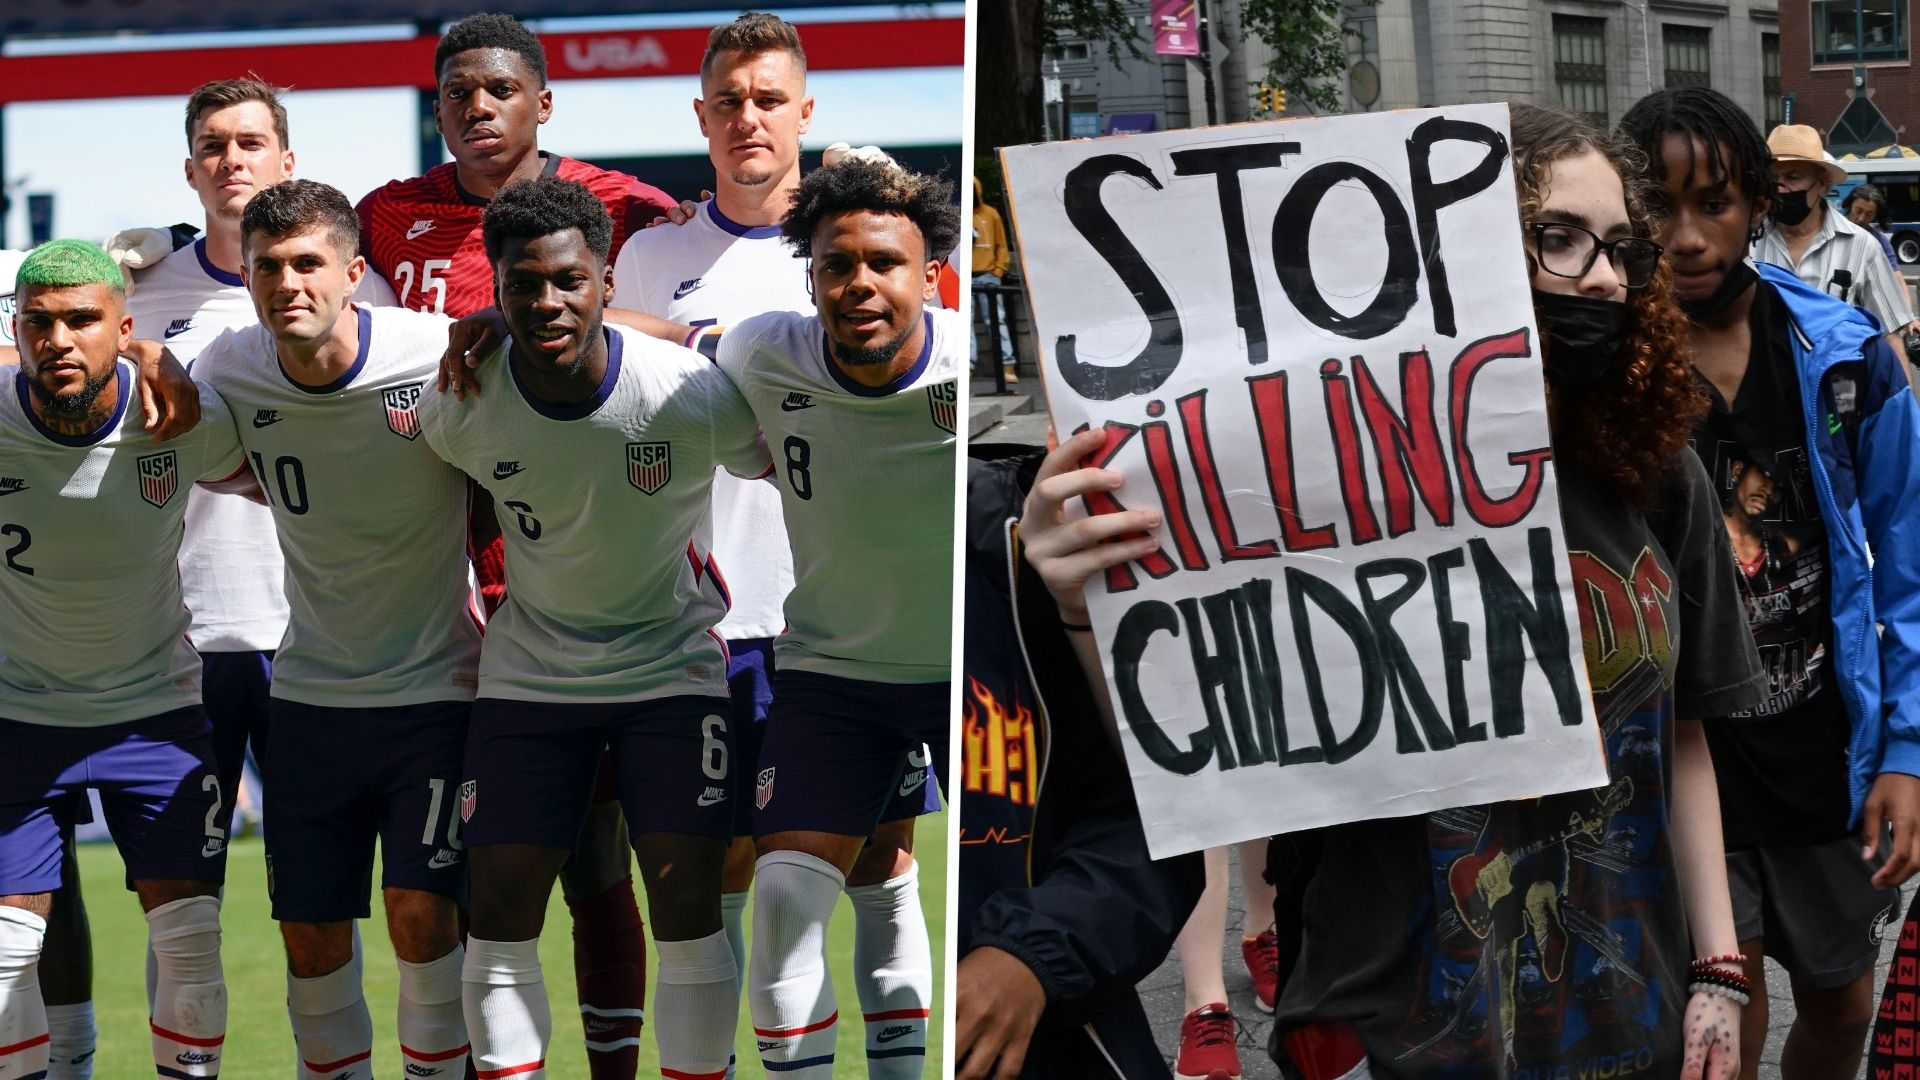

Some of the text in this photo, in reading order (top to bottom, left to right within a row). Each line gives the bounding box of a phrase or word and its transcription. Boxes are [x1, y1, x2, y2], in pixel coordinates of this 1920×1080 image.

[563, 36, 670, 72] USA
[1055, 116, 1510, 401] STOP
[394, 259, 451, 315] 25
[0, 477, 25, 489] NIKE
[142, 455, 173, 477] USA
[251, 450, 309, 515] 10
[631, 446, 666, 466] USA
[784, 435, 813, 501] 8
[1, 523, 35, 577] 2
[1111, 527, 1584, 776] CHILDREN
[701, 714, 728, 780] 6
[202, 774, 225, 839] 2
[1578, 1043, 1654, 1080] VIDEO
